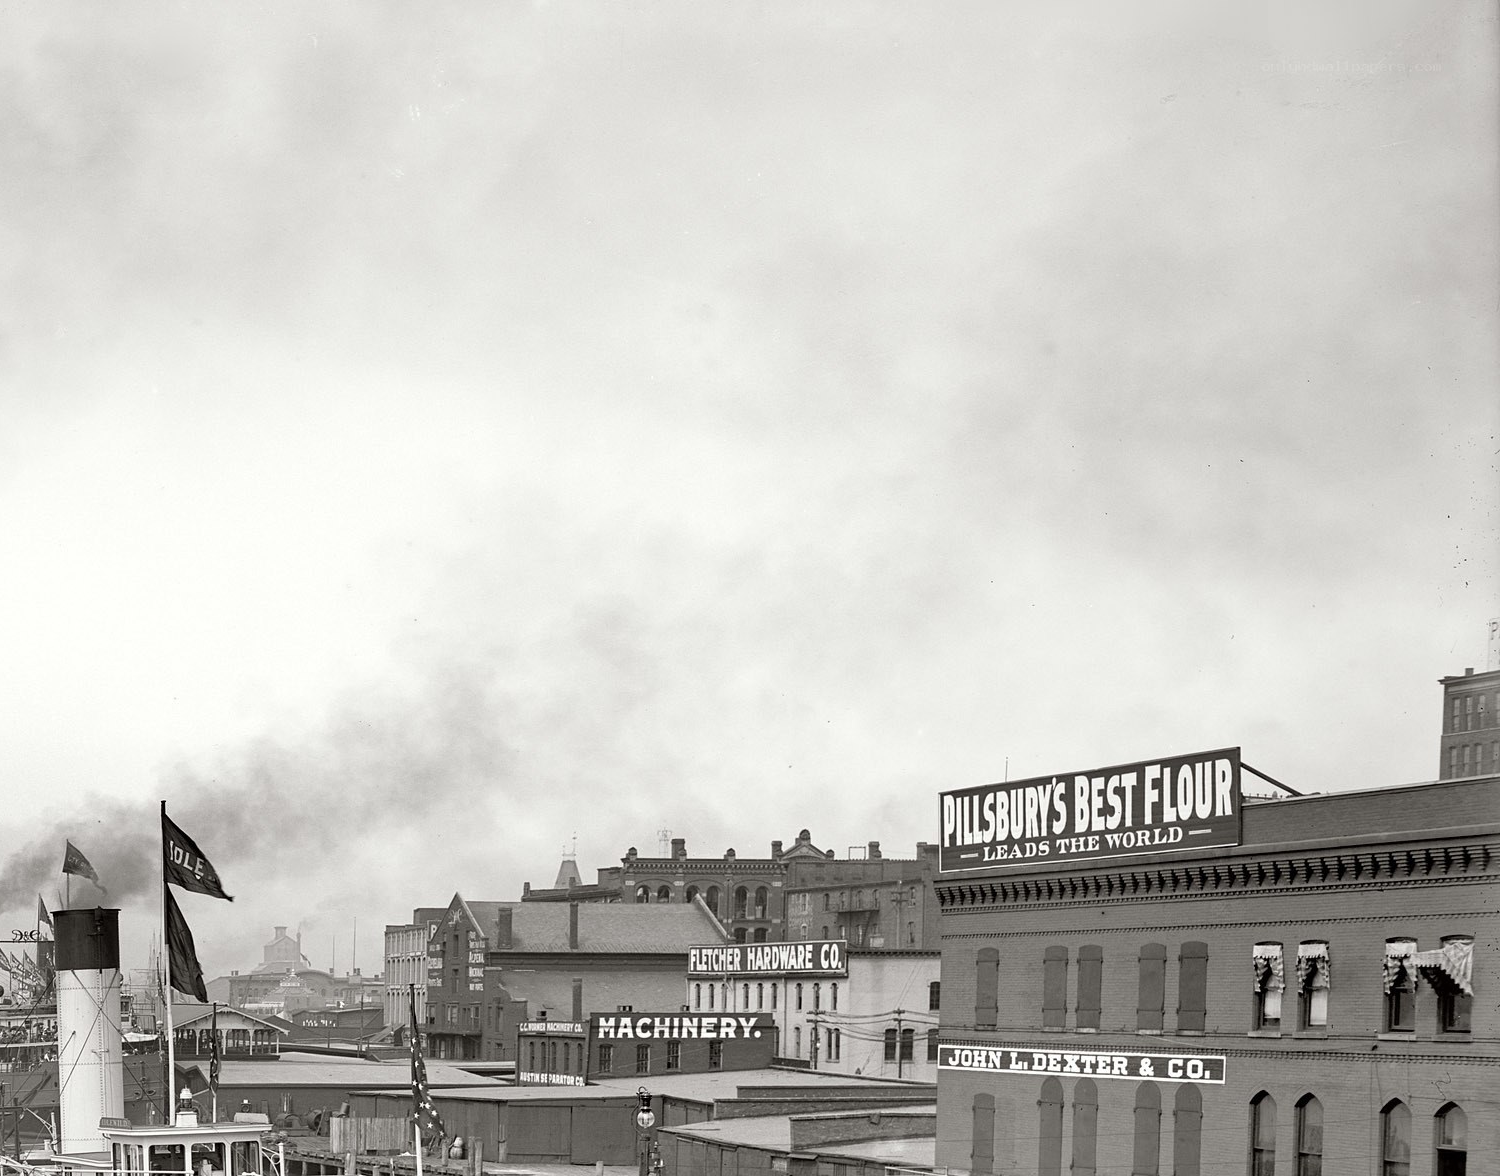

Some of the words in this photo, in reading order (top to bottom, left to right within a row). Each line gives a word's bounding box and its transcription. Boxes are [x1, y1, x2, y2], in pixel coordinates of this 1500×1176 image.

[943, 776, 1067, 848] PILLSBURY'S
[1074, 771, 1138, 833] BEST
[1144, 757, 1233, 828] FLOUR
[982, 841, 1050, 863] LEADS
[1056, 835, 1100, 855] THE
[1105, 826, 1183, 849] WORLD
[690, 944, 740, 974] FLETCHER
[746, 942, 813, 972] HARDWARE
[819, 941, 842, 970] CO.
[598, 1017, 762, 1039] MACHINERY.
[520, 1072, 539, 1083] AUSTIN
[949, 1049, 1002, 1070] JOHN
[1009, 1051, 1028, 1071] L.
[1032, 1053, 1129, 1076] DEXTER
[1139, 1057, 1155, 1077] &
[1167, 1058, 1211, 1080] CO.
